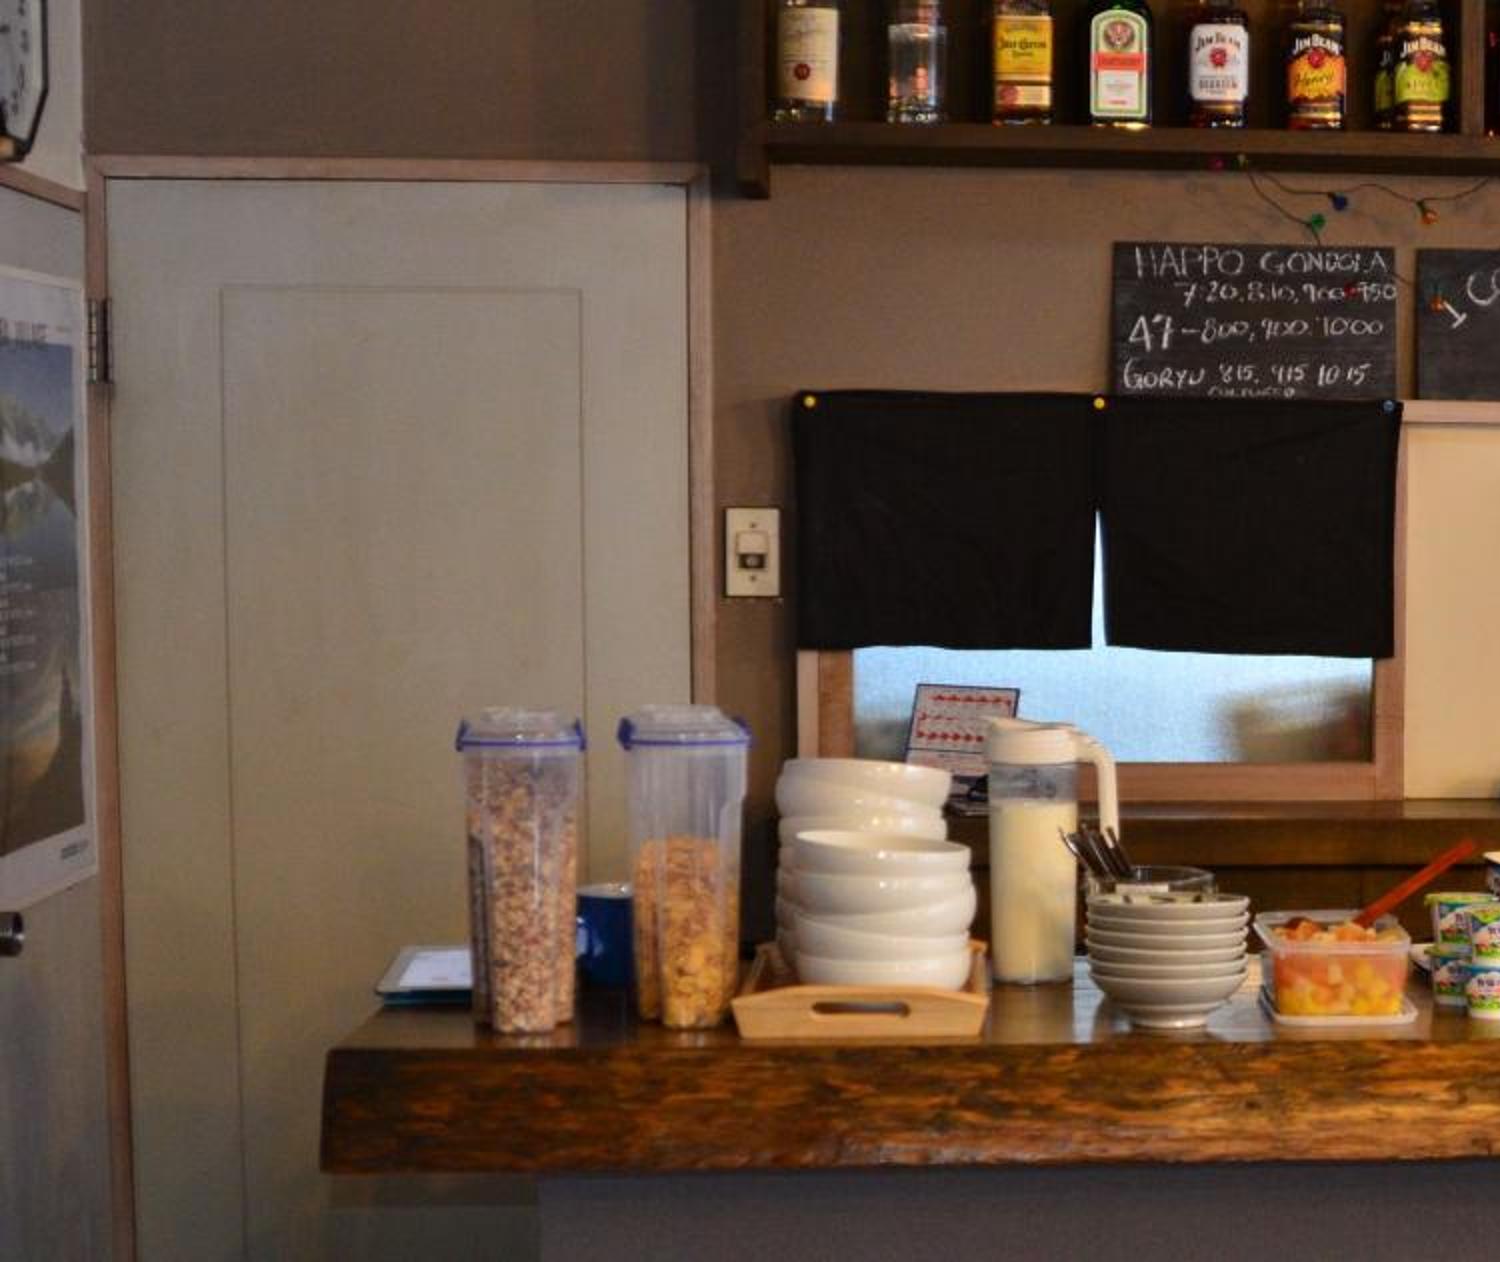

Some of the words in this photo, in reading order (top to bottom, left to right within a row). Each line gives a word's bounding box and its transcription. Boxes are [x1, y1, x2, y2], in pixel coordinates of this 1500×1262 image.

[1135, 246, 1245, 278] HAPPO
[1260, 250, 1387, 275] GONDOLA
[1124, 358, 1205, 390] GORYU
